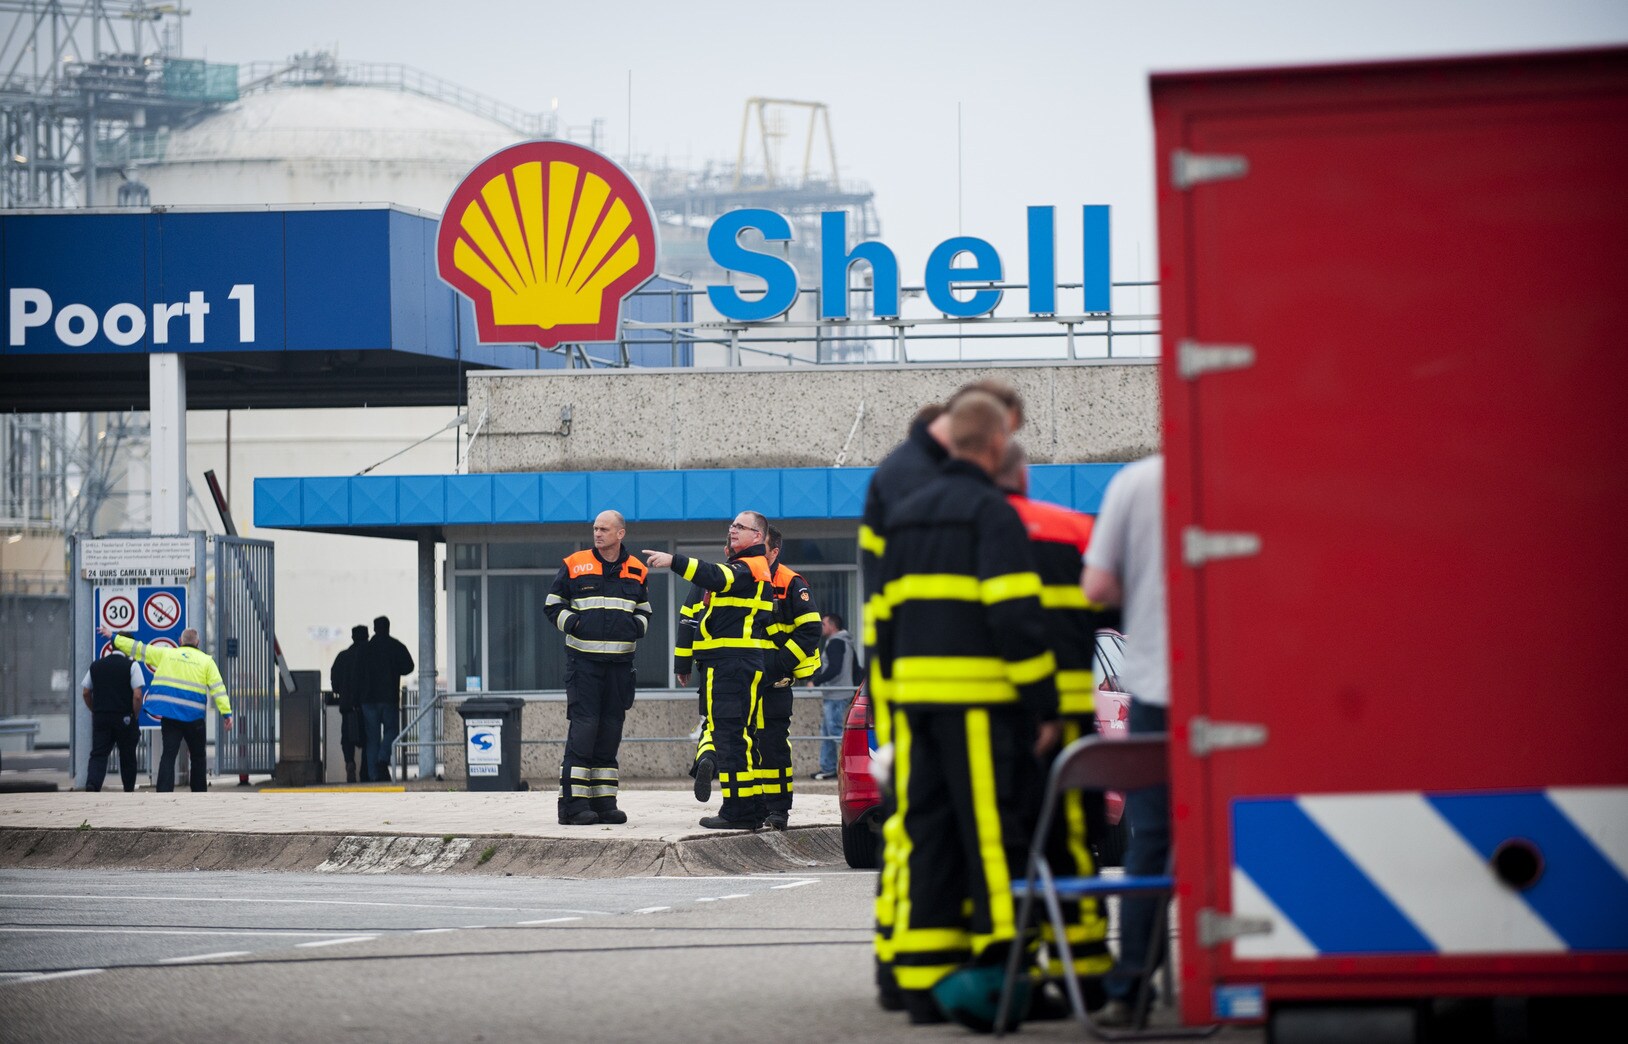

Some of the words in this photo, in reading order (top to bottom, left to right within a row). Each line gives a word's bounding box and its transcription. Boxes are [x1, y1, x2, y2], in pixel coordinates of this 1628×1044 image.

[706, 203, 1113, 322] Shell
[9, 287, 210, 347] Poort
[227, 284, 256, 343] 1
[99, 569, 117, 577] UURS
[119, 569, 147, 577] CAMERA
[149, 568, 189, 576] BEVEILIGING
[573, 563, 594, 574] OVD
[109, 605, 128, 619] 30
